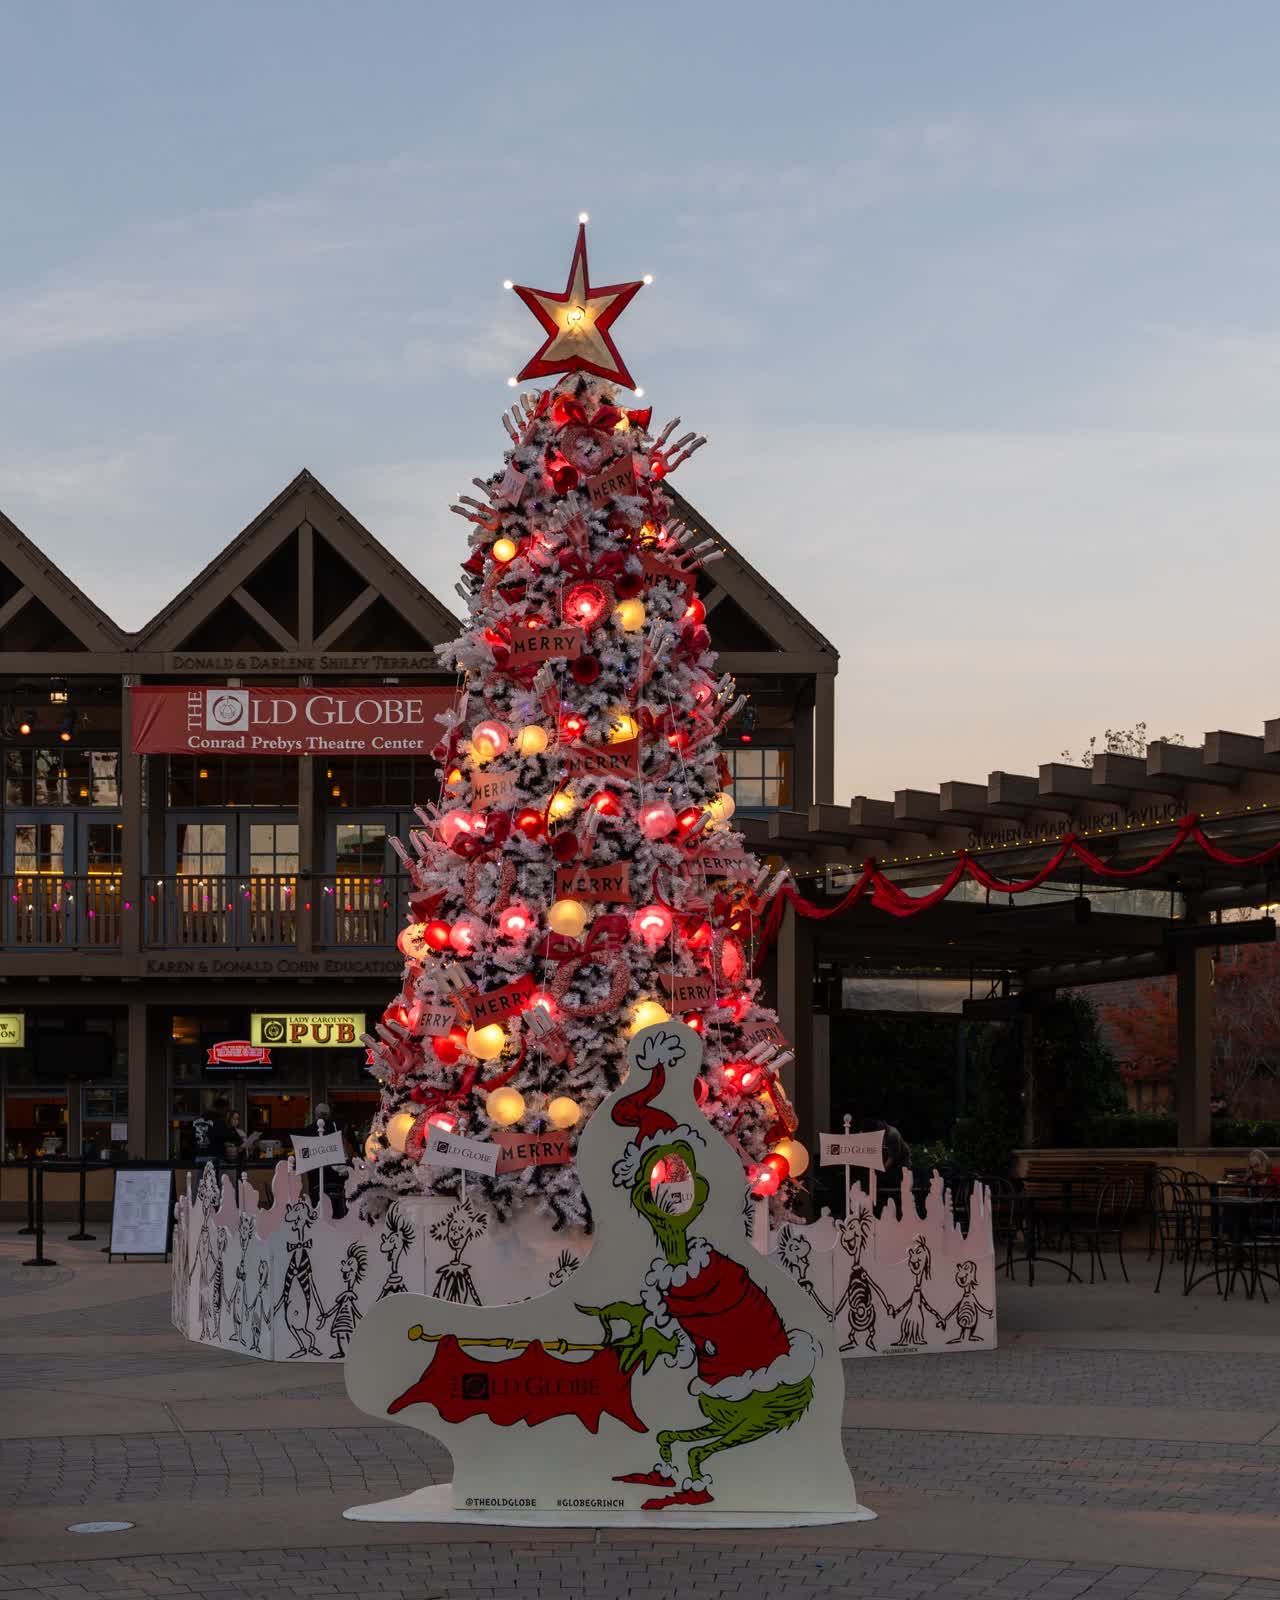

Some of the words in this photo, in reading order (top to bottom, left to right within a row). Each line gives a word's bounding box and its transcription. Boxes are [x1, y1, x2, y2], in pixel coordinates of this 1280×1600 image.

[593, 471, 632, 497] MERRY
[644, 572, 690, 592] MERR
[514, 636, 576, 654] MERRY
[173, 656, 233, 670] DONALD
[236, 657, 246, 670] &
[250, 656, 315, 670] DARLENE
[320, 656, 368, 670] SHILEY
[187, 690, 203, 731] THE
[305, 695, 425, 726] GLOBE
[187, 735, 245, 749] Conrad
[252, 735, 302, 753] Prebys
[306, 736, 366, 750] Theatre
[371, 736, 424, 750] Center
[569, 754, 632, 771] MERRY
[562, 876, 623, 892] MERRY
[147, 960, 194, 974] KAREN
[213, 960, 273, 974] DONALD
[474, 987, 532, 1017] MERRY
[420, 1013, 452, 1028] ERRY
[289, 1023, 356, 1044] PUB
[461, 1148, 493, 1163] GLOBE
[502, 1142, 564, 1160] MERRY
[465, 1497, 537, 1508] @THEOLDGLOBE
[557, 1498, 625, 1508] #GLOBEGRINCH
